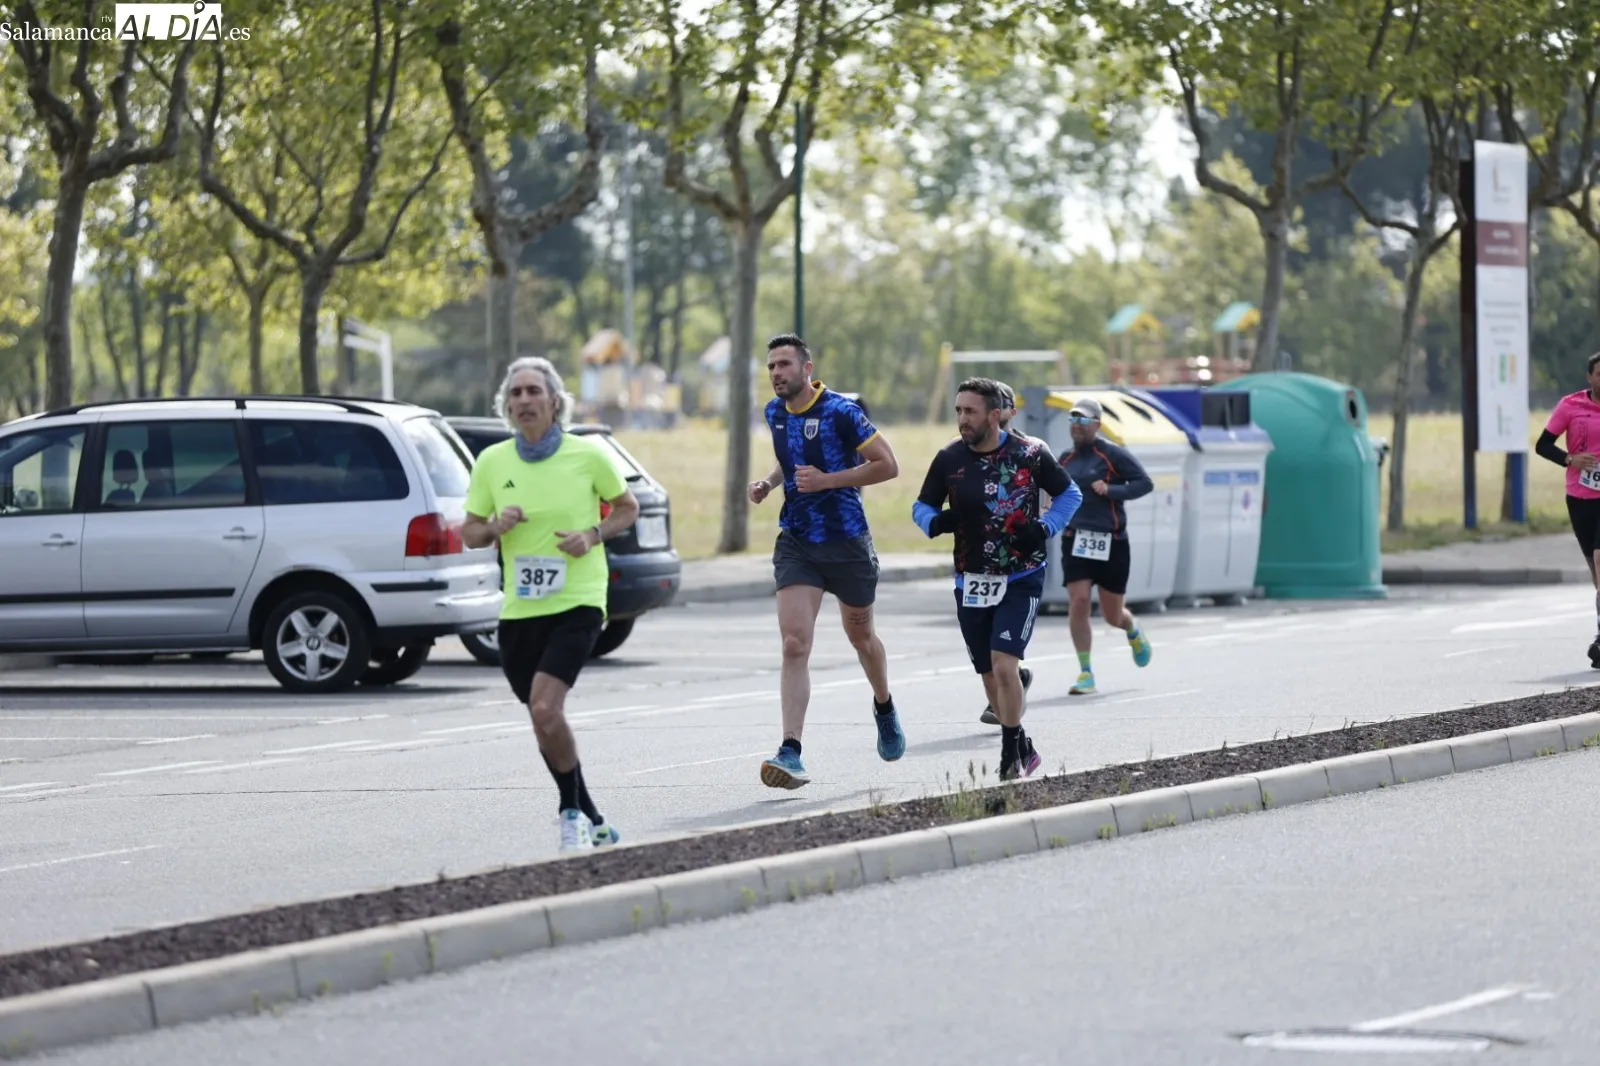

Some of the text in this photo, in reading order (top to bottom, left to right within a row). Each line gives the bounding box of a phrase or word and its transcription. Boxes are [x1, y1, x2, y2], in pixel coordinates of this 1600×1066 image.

[1079, 537, 1107, 552] 338
[521, 567, 559, 587] 387
[968, 580, 1003, 597] 237
